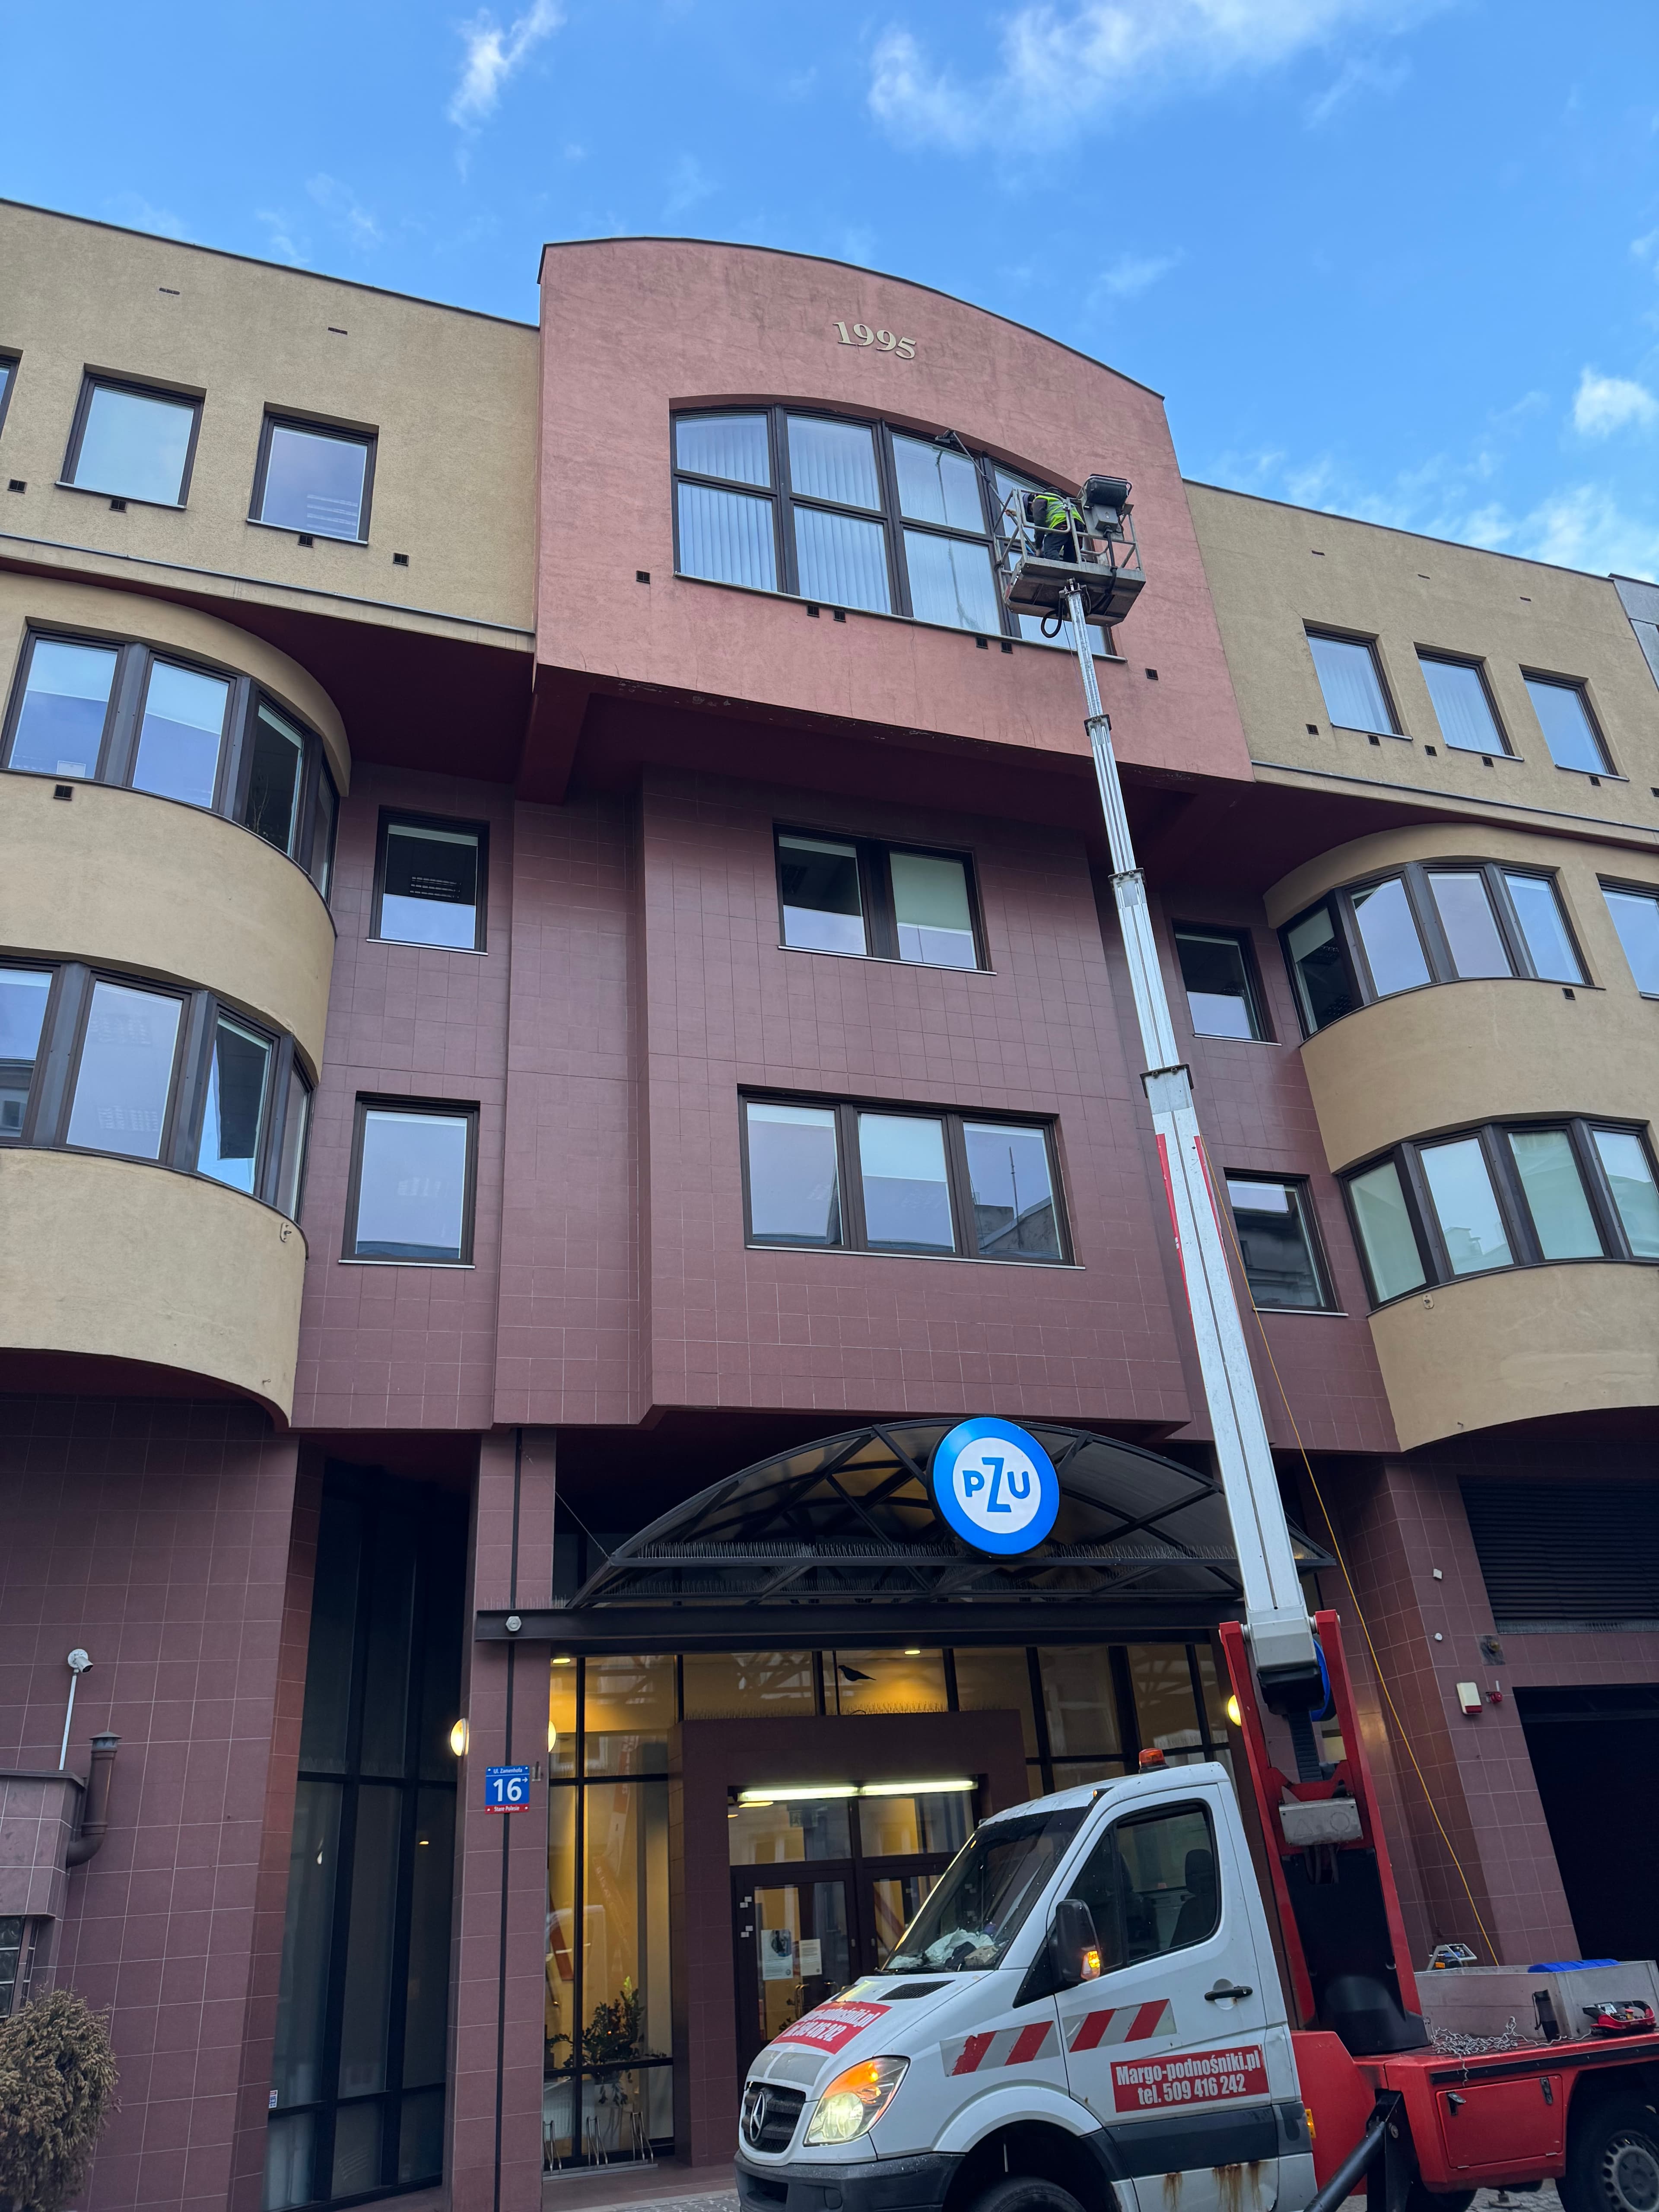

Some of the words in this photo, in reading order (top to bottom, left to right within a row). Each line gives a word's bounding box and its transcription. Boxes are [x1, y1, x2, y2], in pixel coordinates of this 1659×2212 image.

[833, 321, 916, 359] 1995
[962, 1457, 1030, 1513] PZU
[493, 1777, 522, 1802] 16
[805, 2022, 832, 2038] 416
[817, 2024, 847, 2042] 242
[1116, 2050, 1260, 2085] Margo-podnośniki.pl
[1138, 2085, 1161, 2105] tel.
[1163, 2081, 1192, 2102] 509
[1194, 2077, 1218, 2098] 416
[1220, 2073, 1246, 2094] 242
